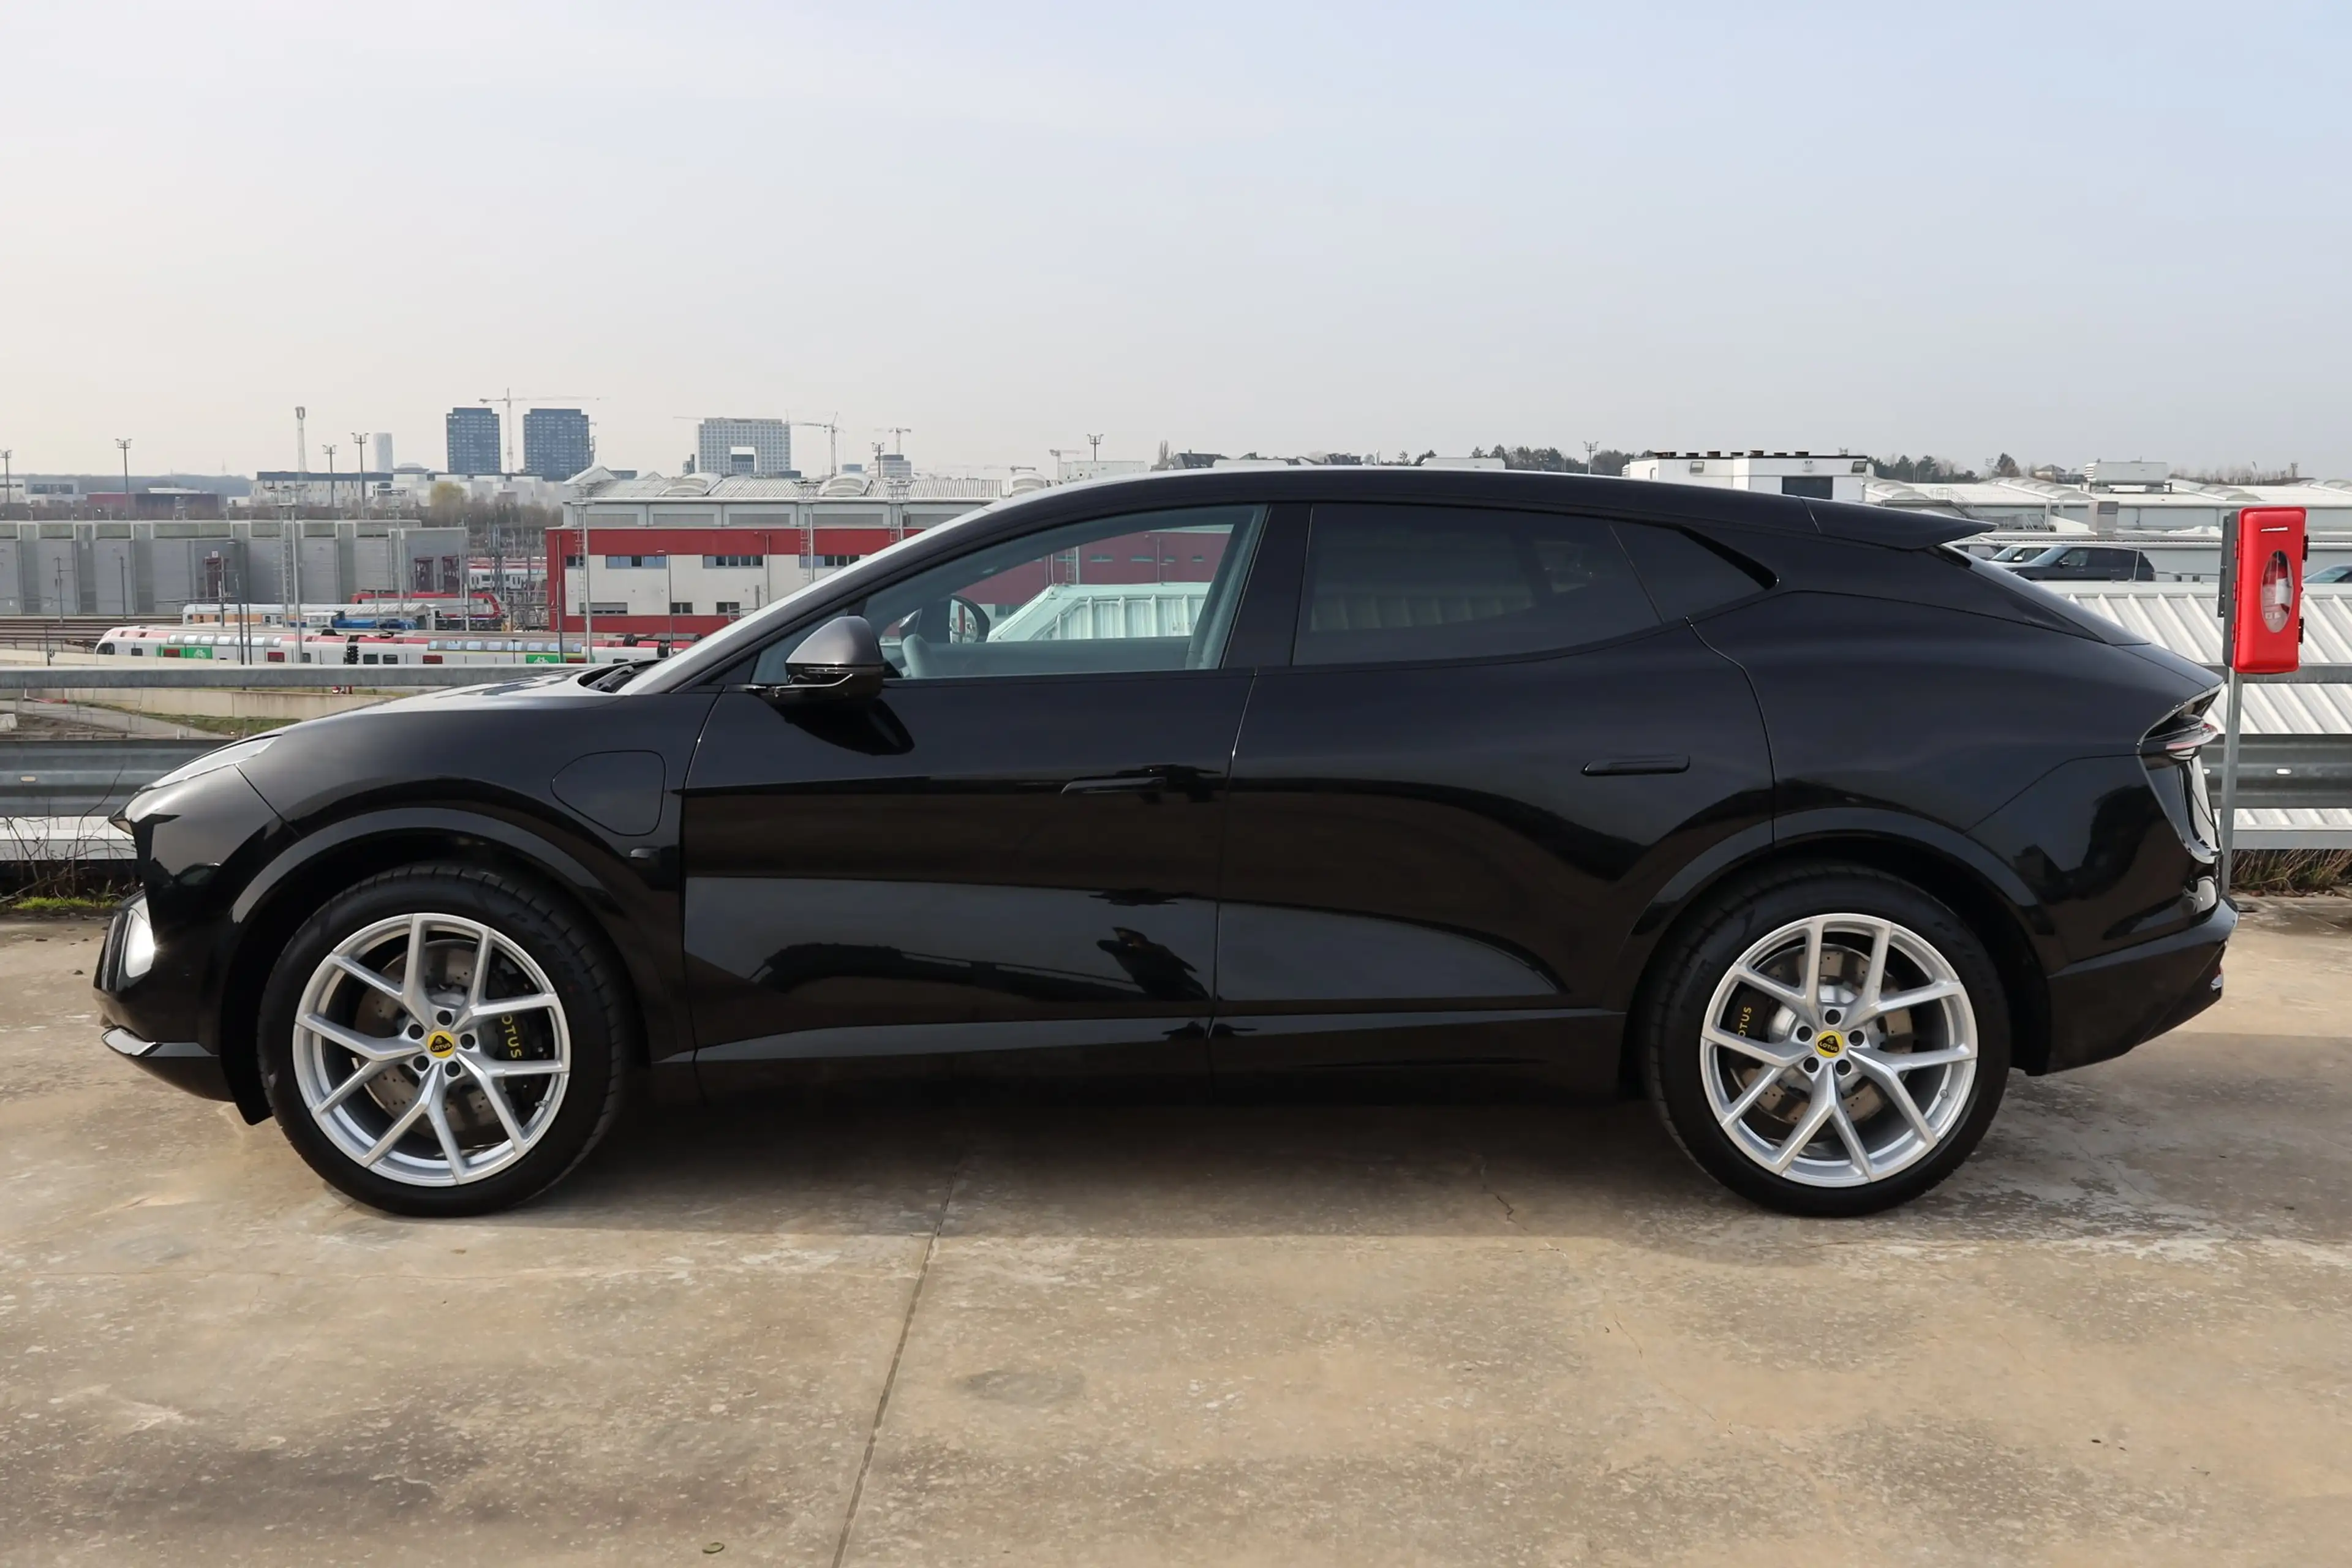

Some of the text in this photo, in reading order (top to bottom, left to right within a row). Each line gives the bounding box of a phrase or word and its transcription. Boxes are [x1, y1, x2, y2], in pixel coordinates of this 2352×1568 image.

[1738, 1007, 1752, 1036] OTUS
[502, 1014, 522, 1058] OTUS
[431, 1042, 451, 1051] LOTUS
[1819, 1041, 1838, 1052] LOTUS
